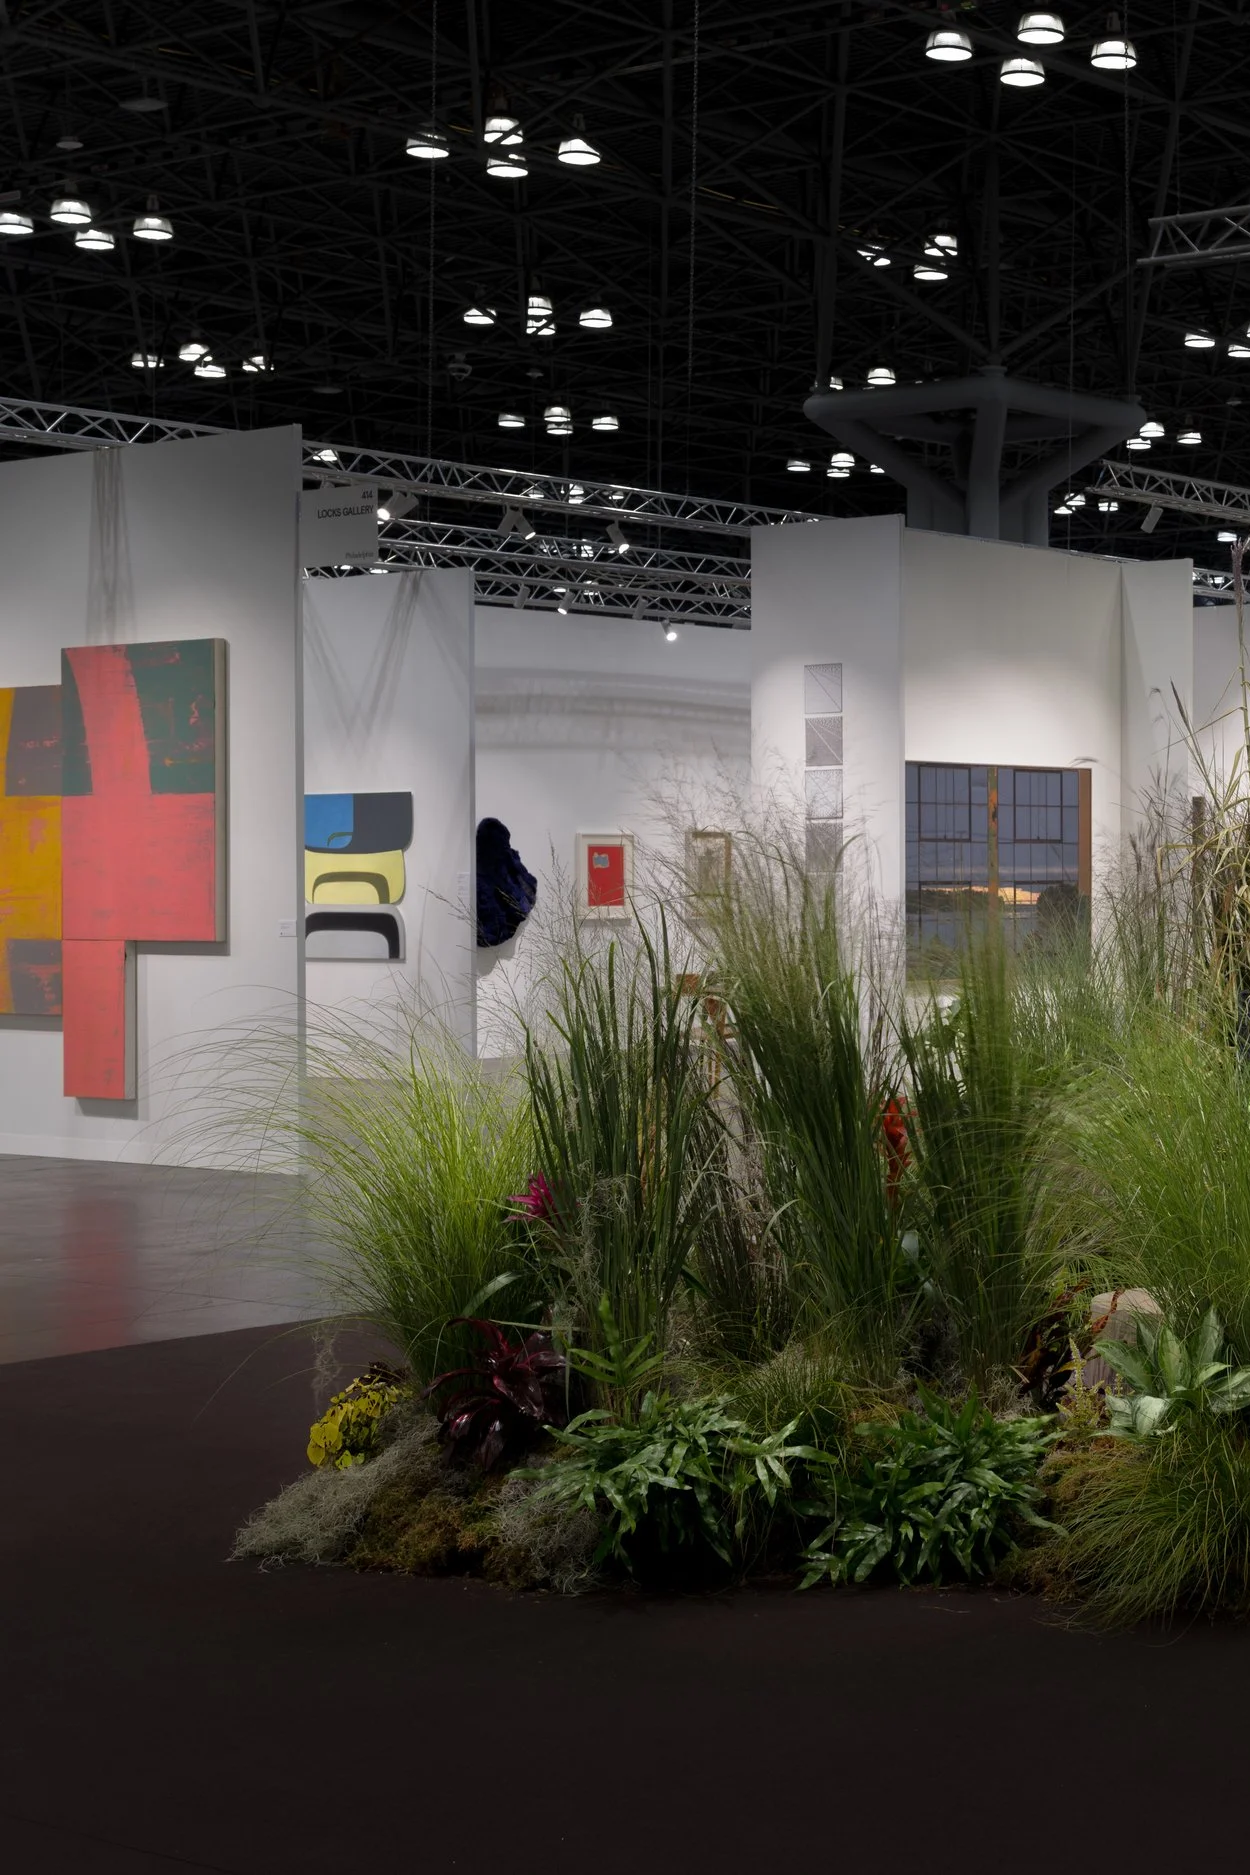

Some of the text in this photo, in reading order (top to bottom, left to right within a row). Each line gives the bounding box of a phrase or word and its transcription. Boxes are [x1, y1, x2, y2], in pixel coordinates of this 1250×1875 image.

[361, 490, 373, 499] 414
[317, 505, 374, 519] LOCKS GALLERY
